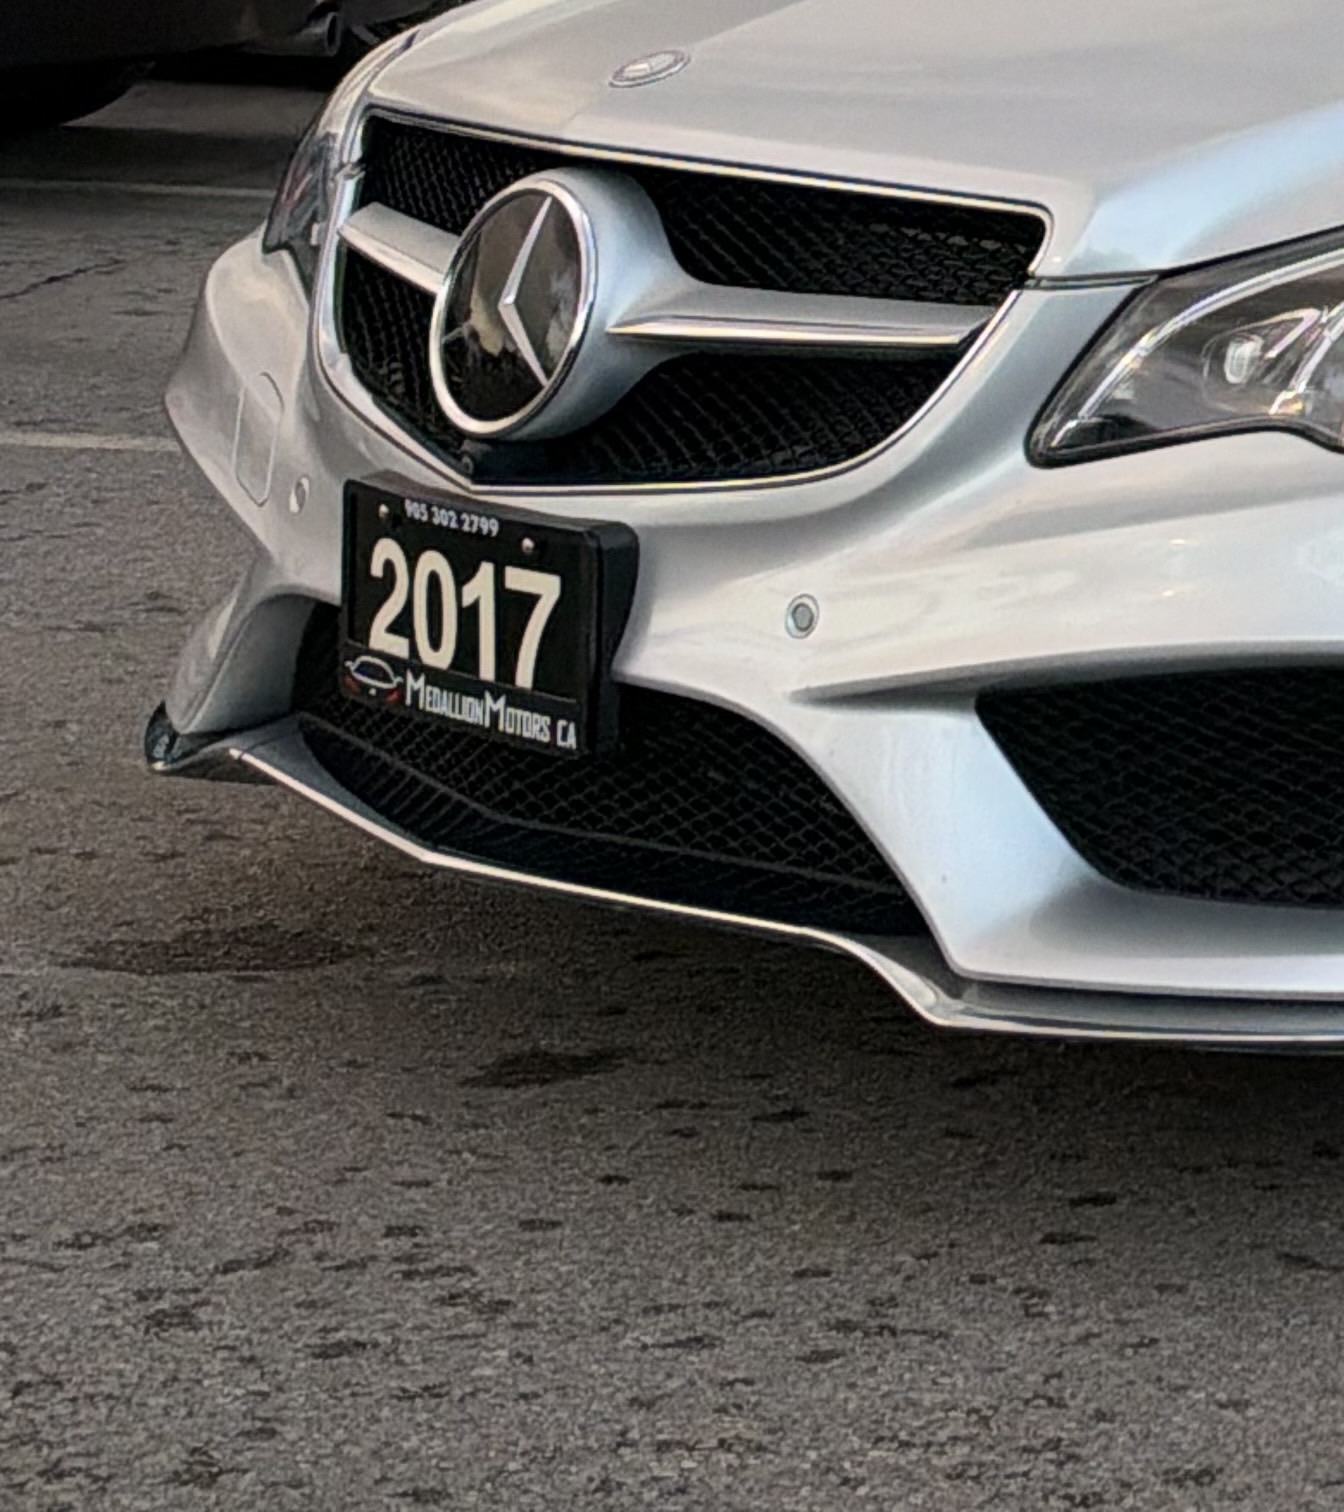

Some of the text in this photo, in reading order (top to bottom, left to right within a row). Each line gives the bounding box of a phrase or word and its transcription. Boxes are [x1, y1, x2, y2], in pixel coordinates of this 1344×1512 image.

[431, 506, 458, 529] 302
[461, 514, 500, 537] 2799
[368, 537, 562, 691] 2017
